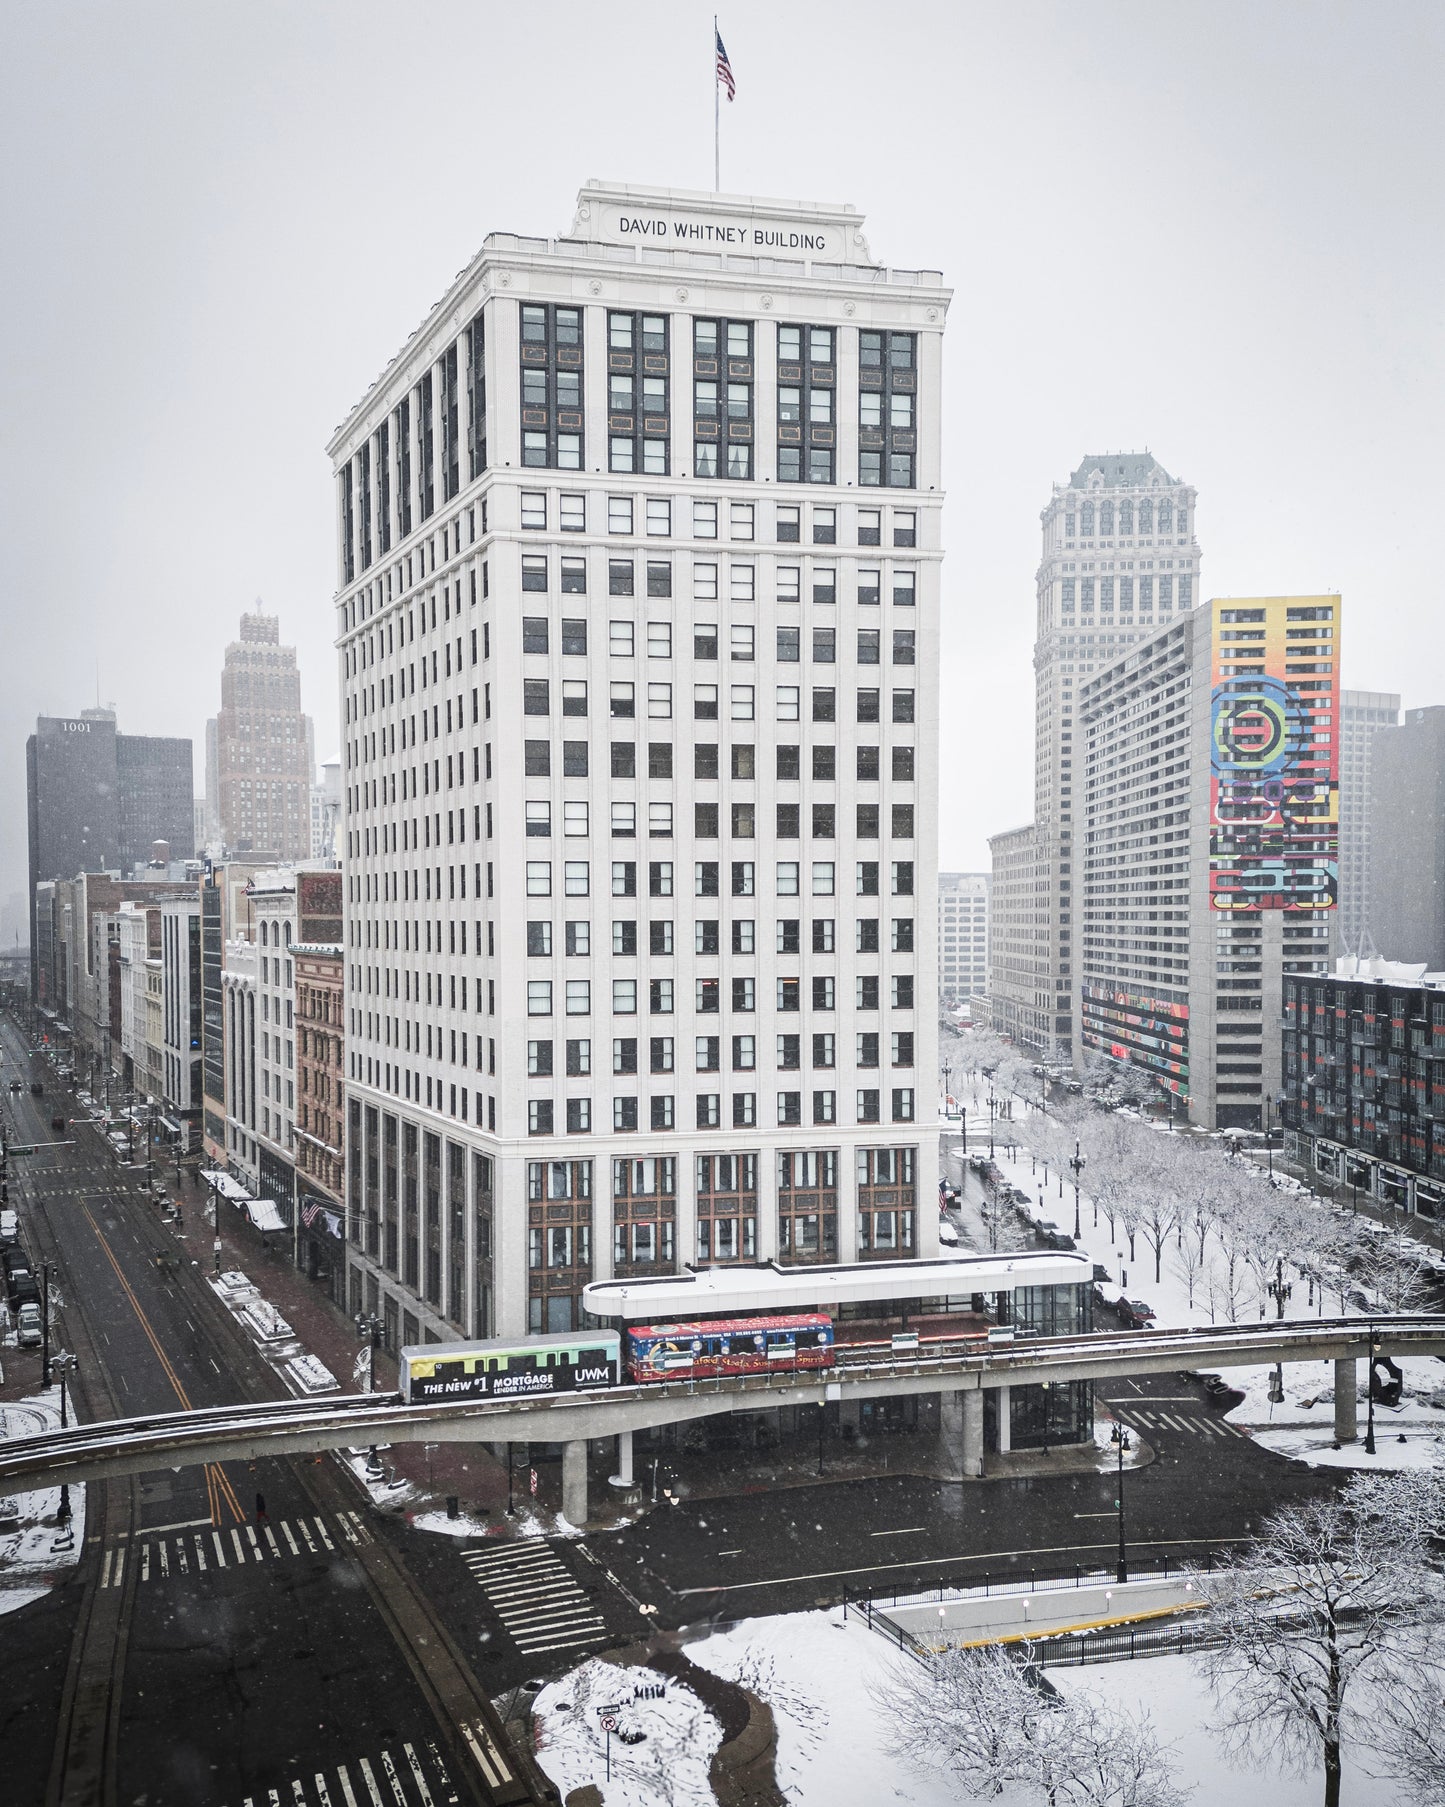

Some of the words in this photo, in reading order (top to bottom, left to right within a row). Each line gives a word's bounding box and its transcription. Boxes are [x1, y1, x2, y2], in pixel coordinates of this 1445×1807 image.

[619, 217, 667, 236] DAVID
[674, 222, 747, 243] WHITNEY
[754, 230, 825, 250] BUILDING
[62, 722, 91, 732] 1001
[575, 1367, 609, 1381] UWM
[424, 1384, 444, 1394] THE
[445, 1381, 472, 1392] NEW
[493, 1374, 553, 1388] MORTGAGE
[493, 1386, 517, 1394] LENDER
